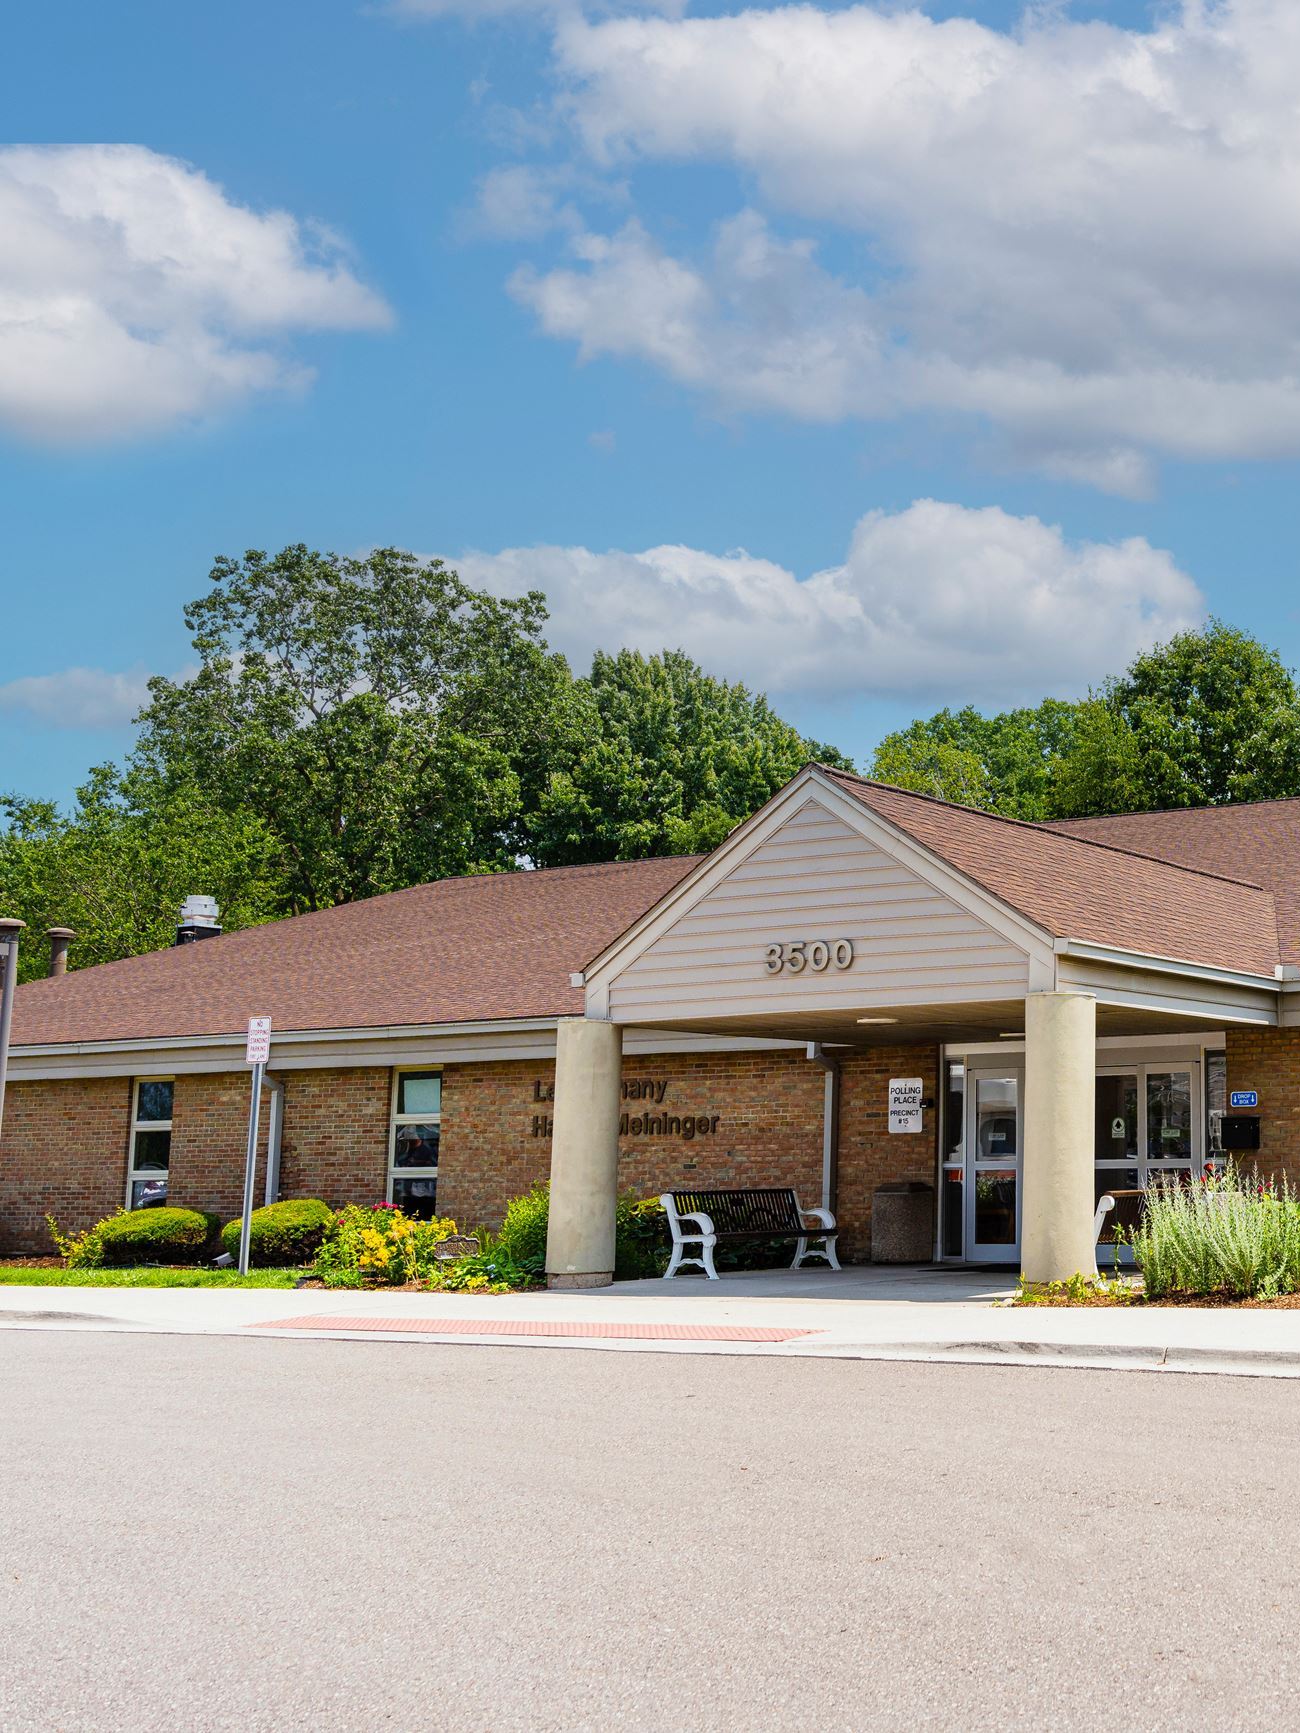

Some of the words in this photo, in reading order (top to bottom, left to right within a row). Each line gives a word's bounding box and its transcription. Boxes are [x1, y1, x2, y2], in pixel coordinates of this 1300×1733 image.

[764, 939, 855, 975] 3500
[890, 1086, 921, 1095] POLLING
[893, 1096, 917, 1104] PLACE
